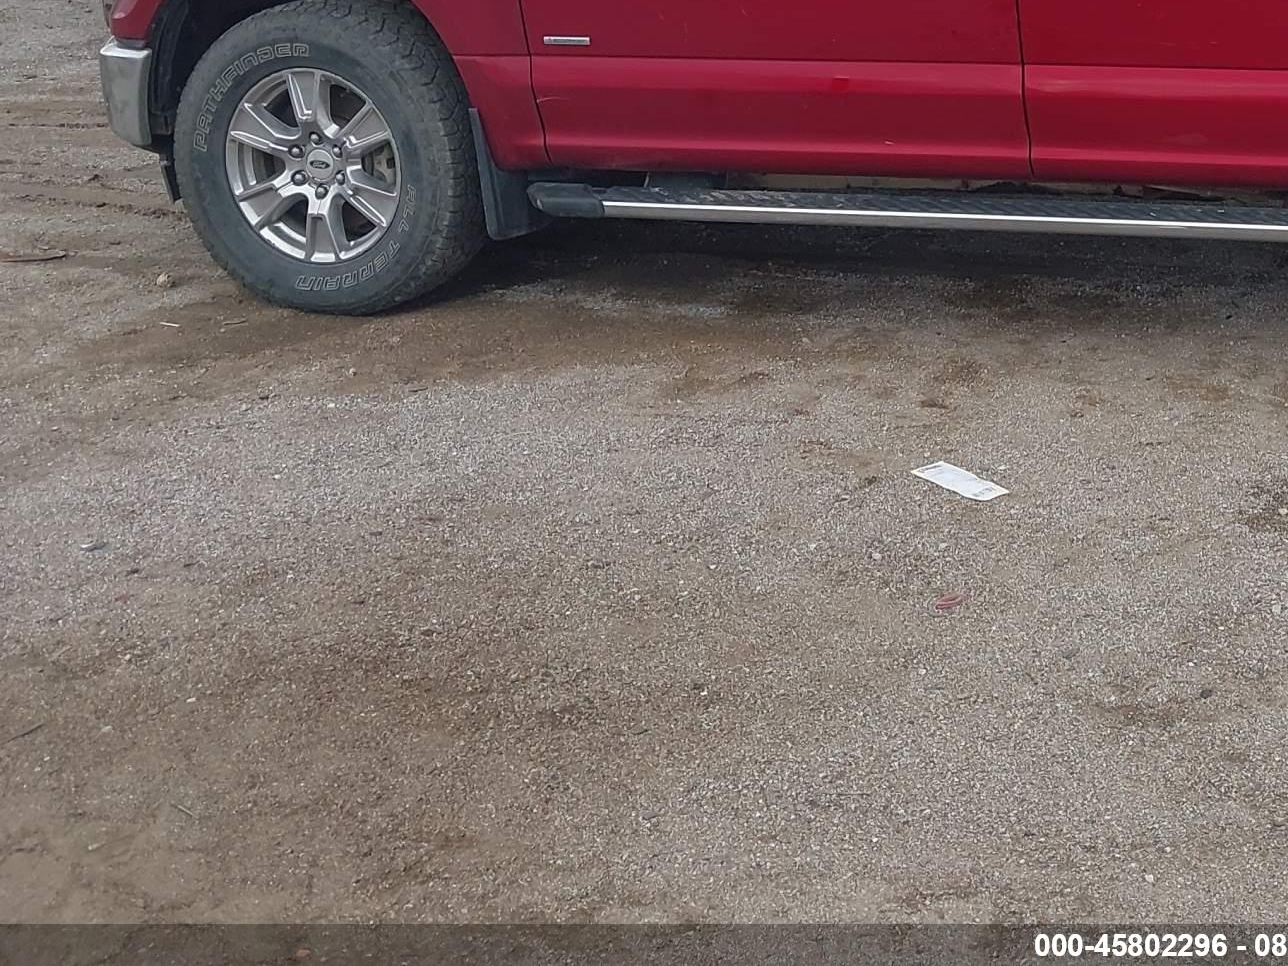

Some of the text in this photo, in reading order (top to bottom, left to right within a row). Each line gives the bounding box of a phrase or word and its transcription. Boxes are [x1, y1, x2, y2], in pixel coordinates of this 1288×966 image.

[193, 43, 310, 151] PATHFINDER
[295, 184, 417, 291] ALL TERRAIN
